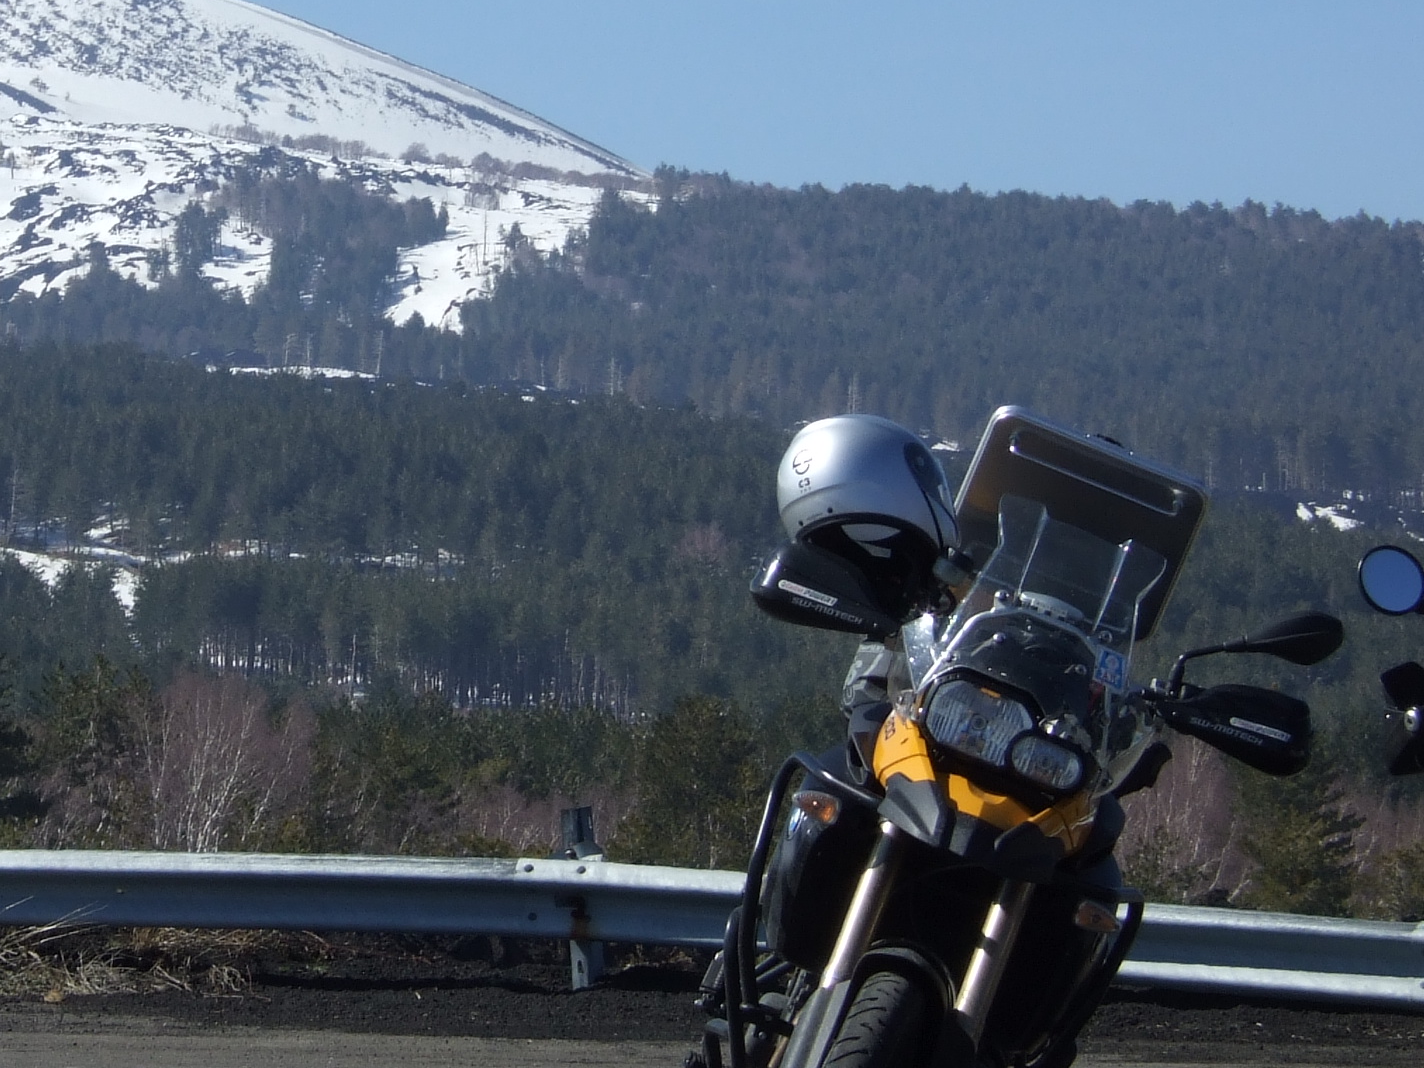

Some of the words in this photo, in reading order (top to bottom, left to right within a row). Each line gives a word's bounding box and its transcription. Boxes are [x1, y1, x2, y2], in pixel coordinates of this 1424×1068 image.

[798, 477, 811, 488] C3
[791, 596, 864, 625] SW-MOTECH
[1190, 717, 1264, 746] SW-MOTECH
